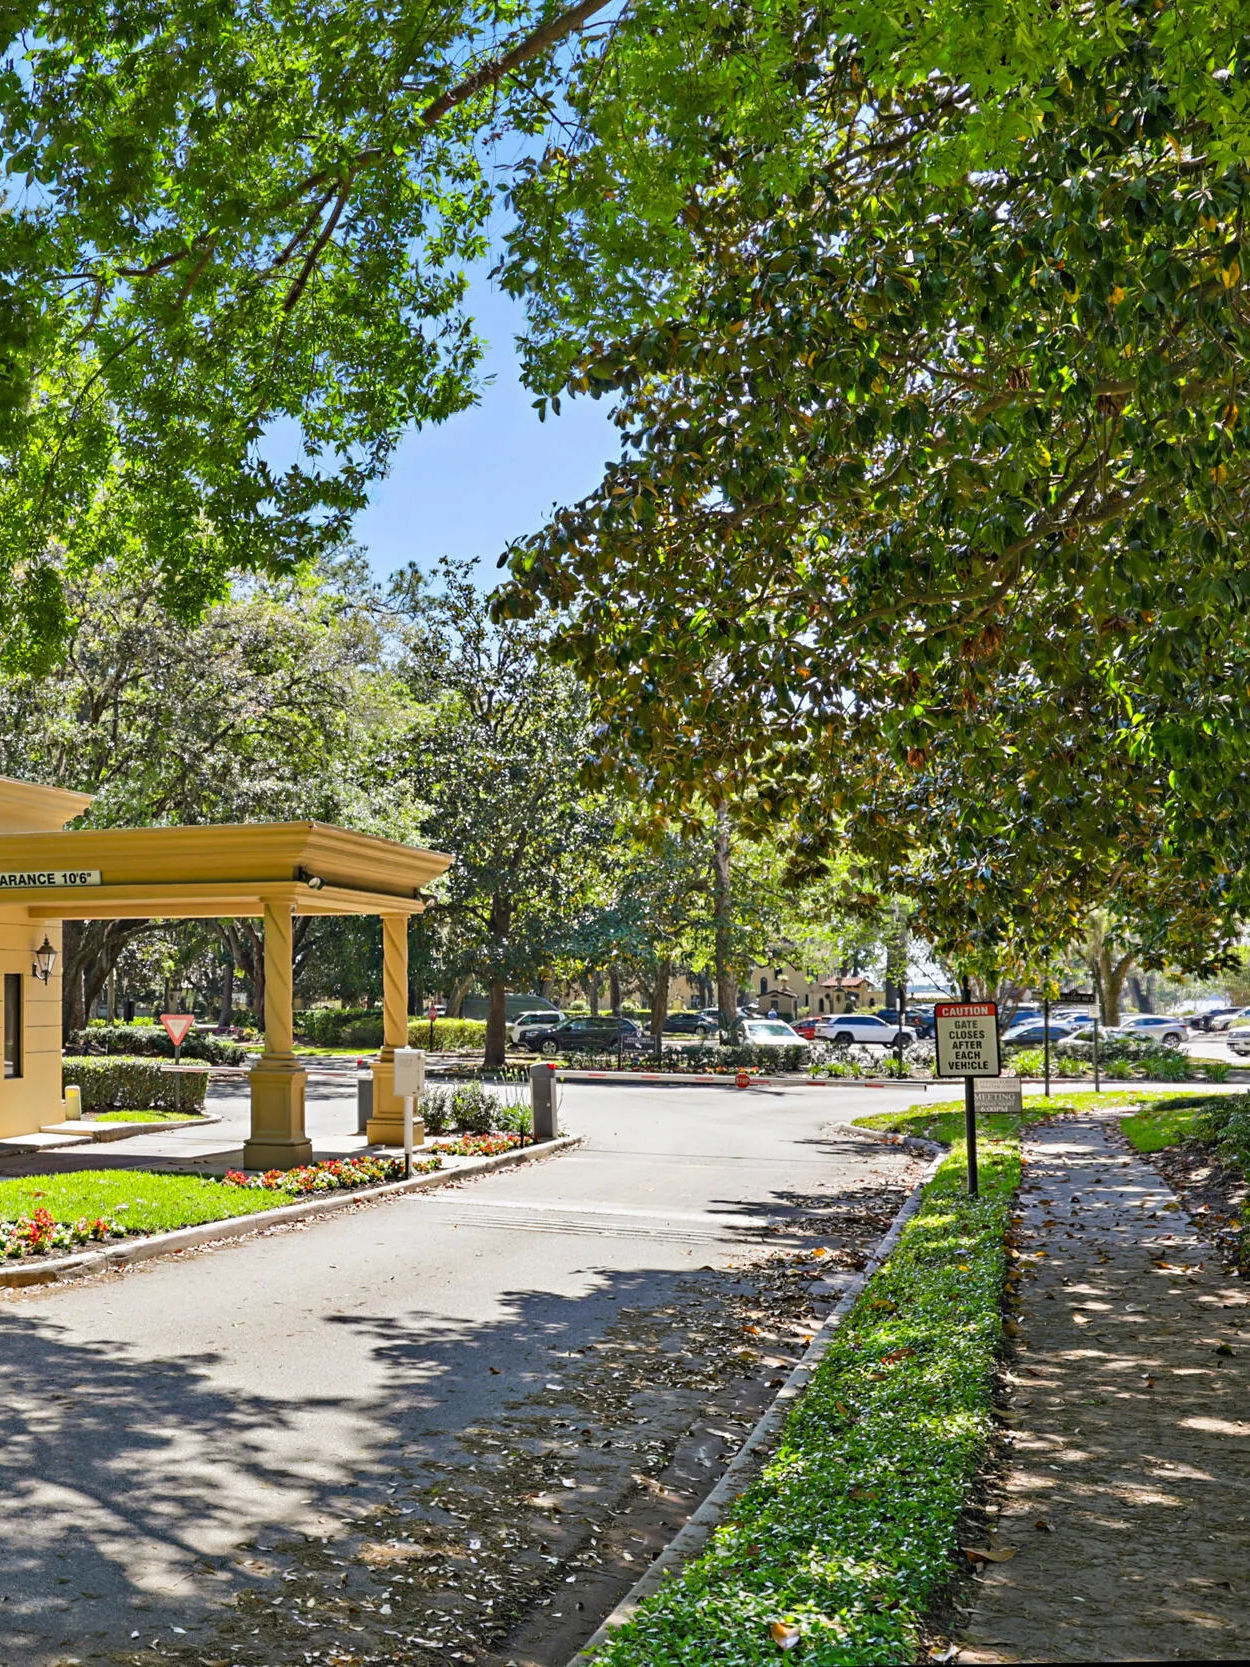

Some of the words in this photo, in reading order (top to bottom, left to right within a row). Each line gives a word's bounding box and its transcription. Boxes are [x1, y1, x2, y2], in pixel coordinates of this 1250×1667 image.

[61, 872, 92, 885] 10'6"
[942, 1006, 989, 1017] CAUTION
[954, 1020, 978, 1030] GATE
[949, 1030, 985, 1040] CLOSES
[952, 1041, 983, 1050] AFTER
[955, 1051, 981, 1060] EACH
[948, 1061, 989, 1070] VEHICLE
[974, 1093, 1015, 1101] MEETING
